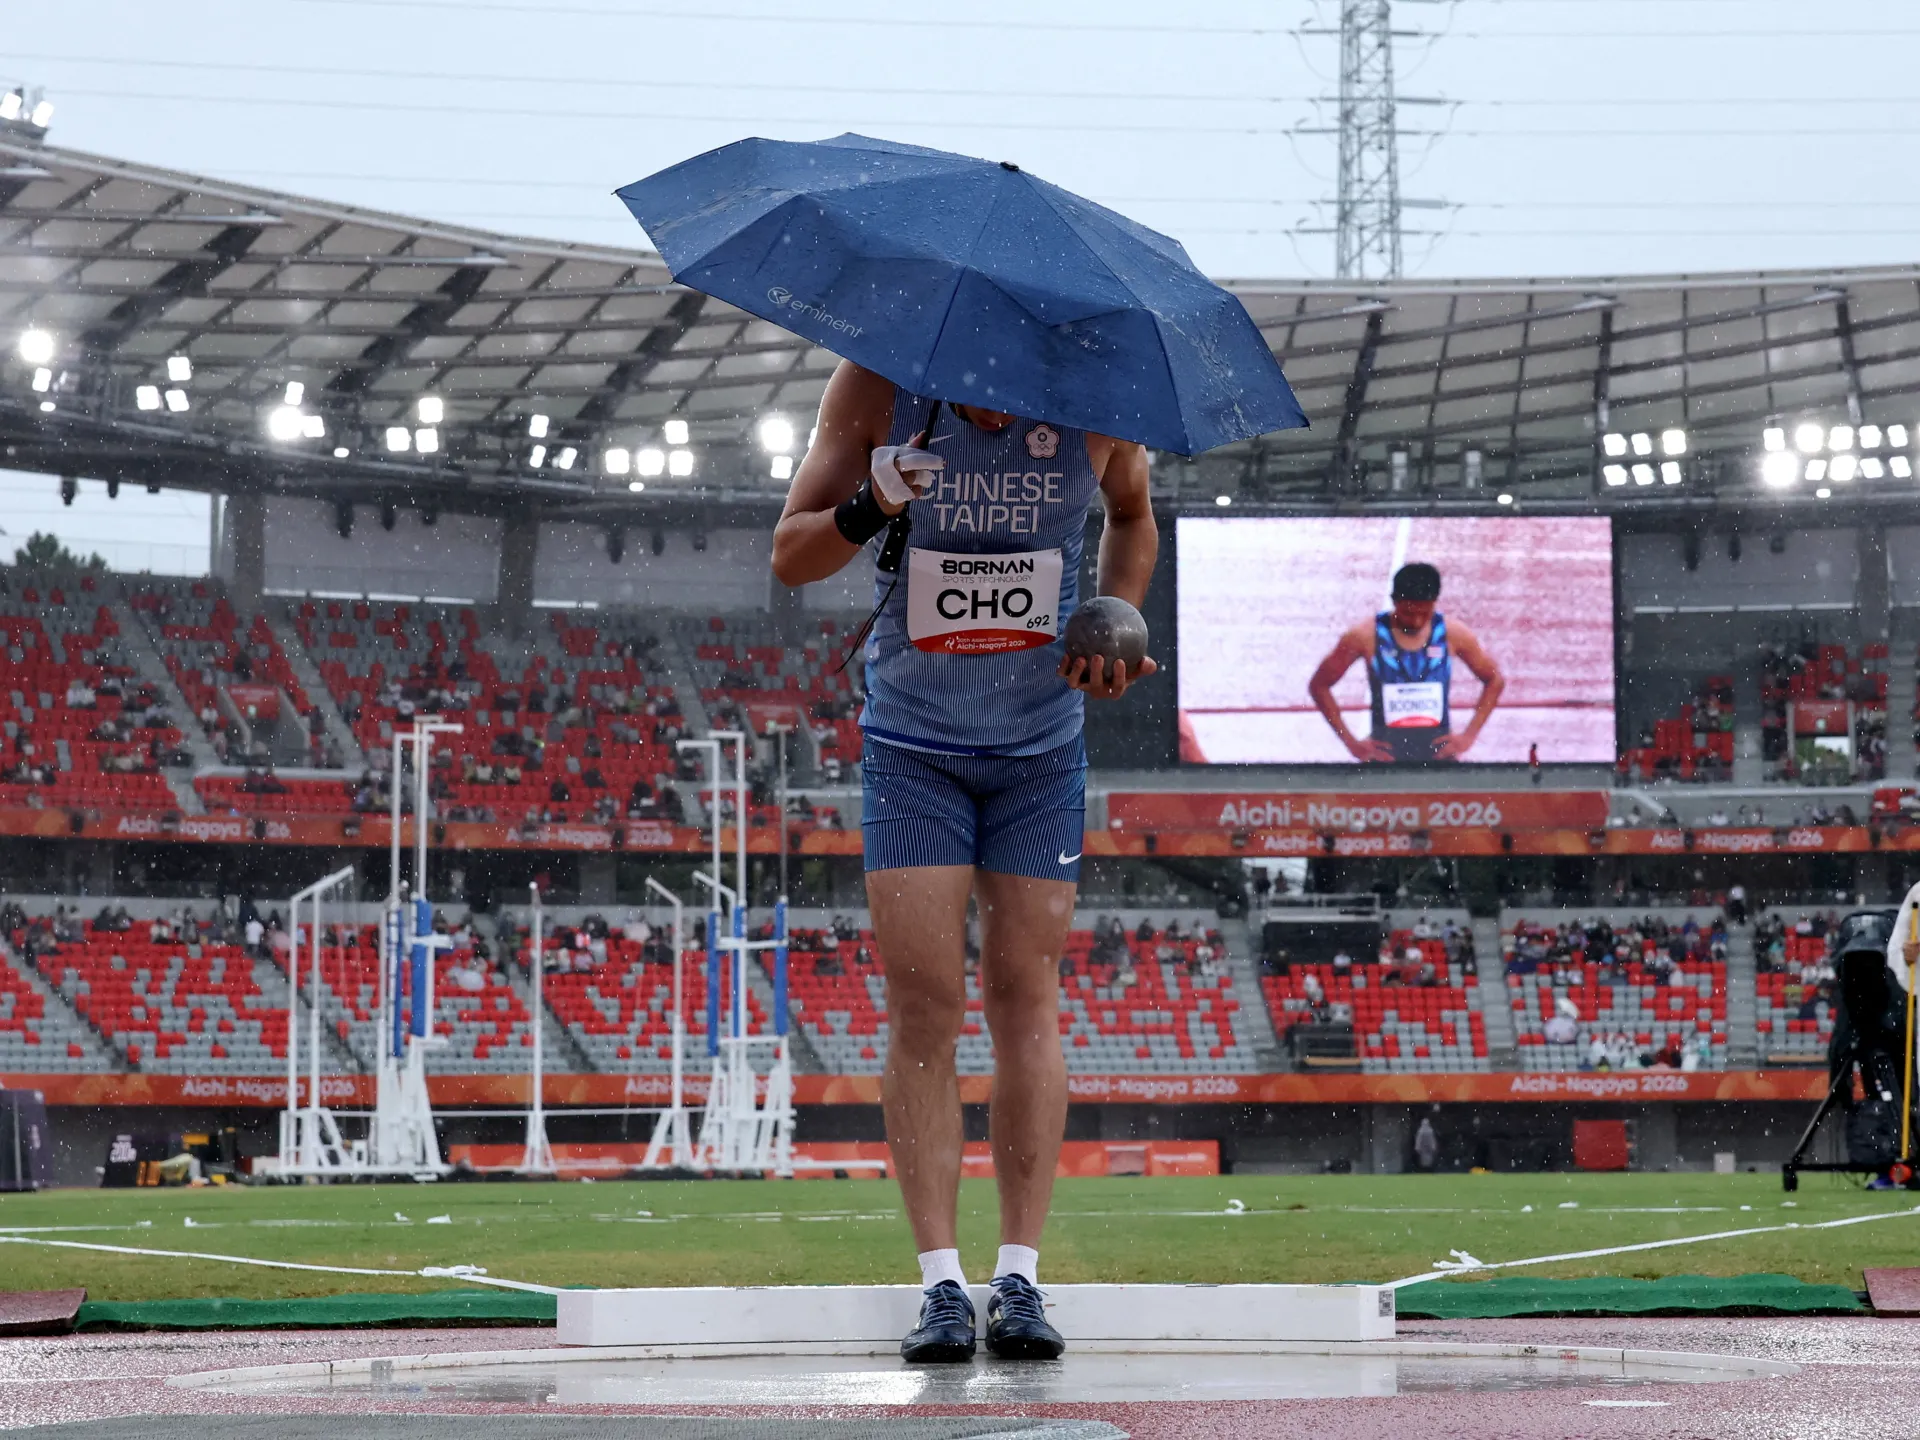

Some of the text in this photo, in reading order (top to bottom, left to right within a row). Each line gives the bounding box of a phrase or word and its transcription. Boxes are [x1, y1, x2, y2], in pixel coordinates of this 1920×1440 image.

[791, 300, 863, 338] eminent
[933, 504, 1039, 533] TAIPEI
[940, 558, 1034, 575] BORNAN
[942, 575, 1033, 584] SPORTS TECHNOLOGY
[936, 587, 1033, 620] CHO
[1026, 614, 1050, 629] 692
[957, 642, 1007, 650] Aichi-Nagoya
[1219, 799, 1502, 832] Aichi-Nagoya 2026
[246, 818, 291, 838] 226
[1651, 831, 1824, 851] Aic-Nagoya 026
[182, 1078, 355, 1102] Aichi-Nagoa 026
[1192, 1077, 1239, 1095] 2026
[1511, 1074, 1688, 1096] Aichi-Nagoya 2026
